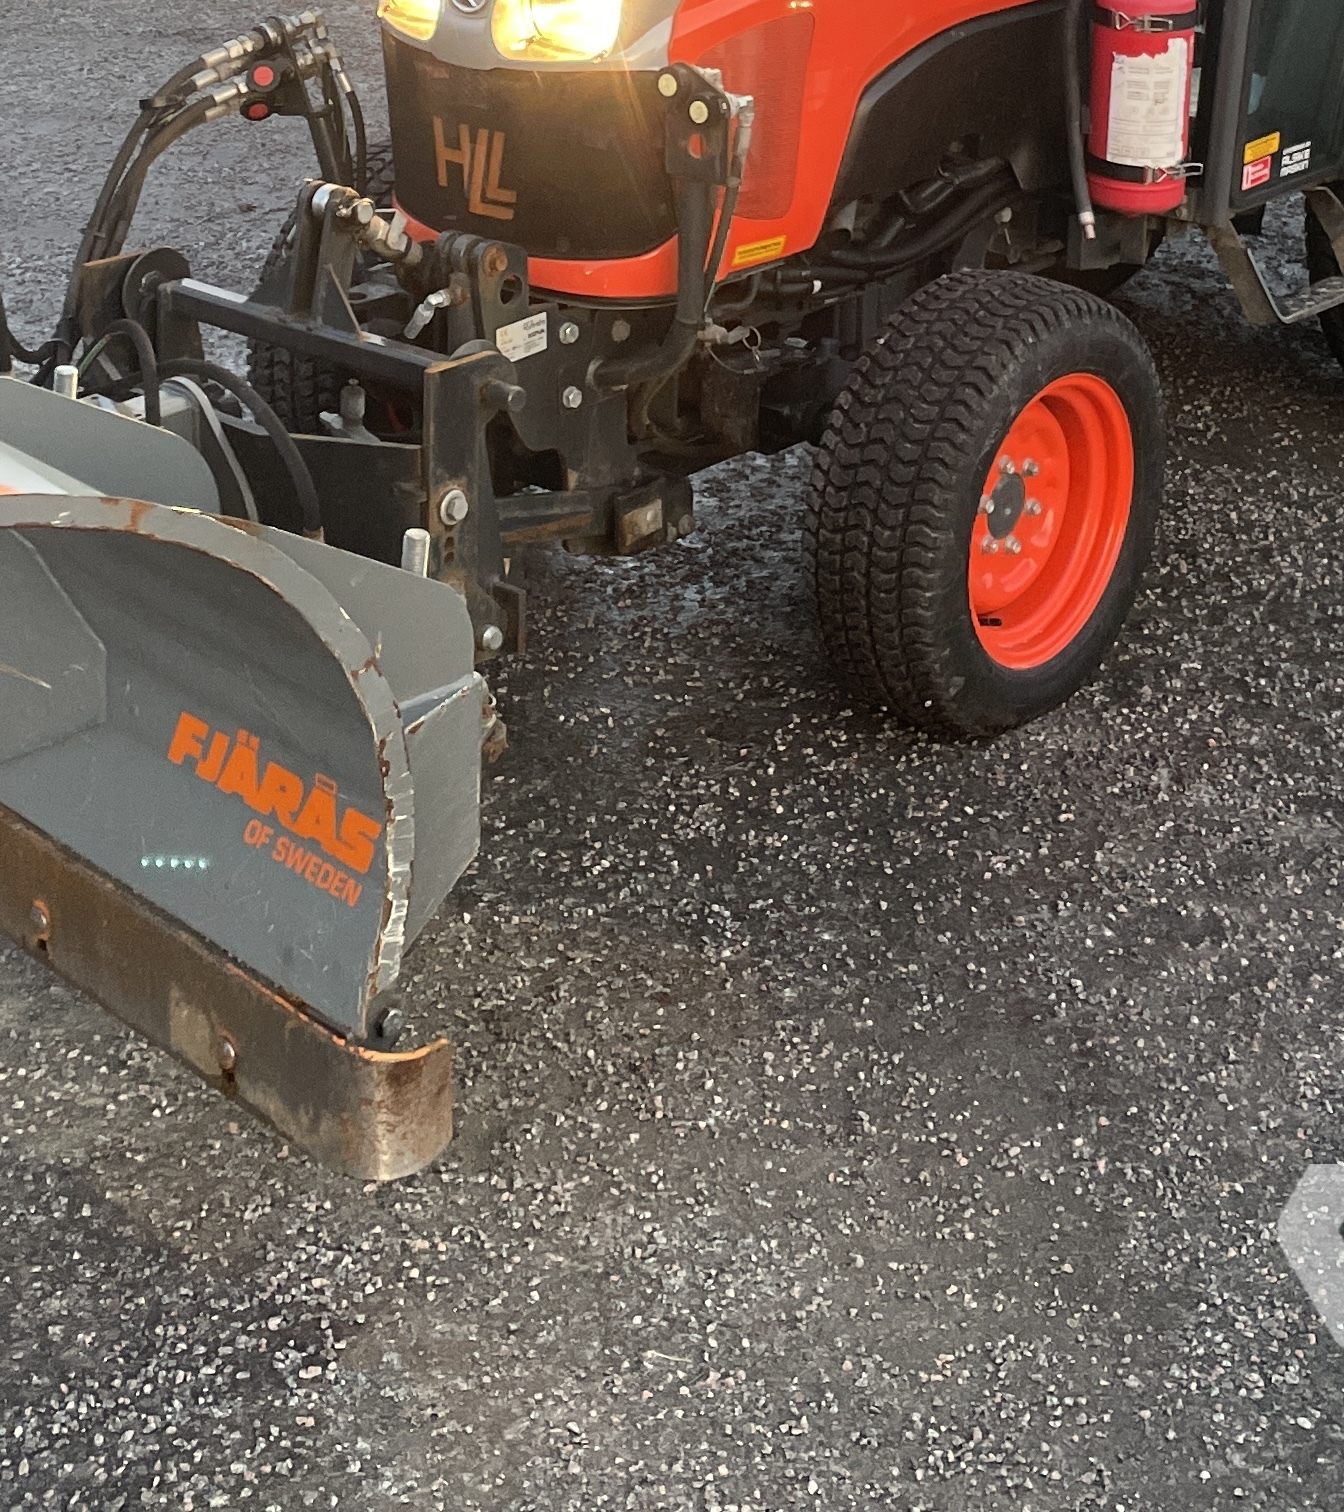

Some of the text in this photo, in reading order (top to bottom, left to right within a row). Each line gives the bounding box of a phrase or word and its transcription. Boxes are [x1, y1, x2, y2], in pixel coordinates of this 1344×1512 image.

[432, 116, 518, 221] HLL
[167, 710, 383, 875] FJÄRÅS
[243, 818, 363, 909] OF SWEDEN
